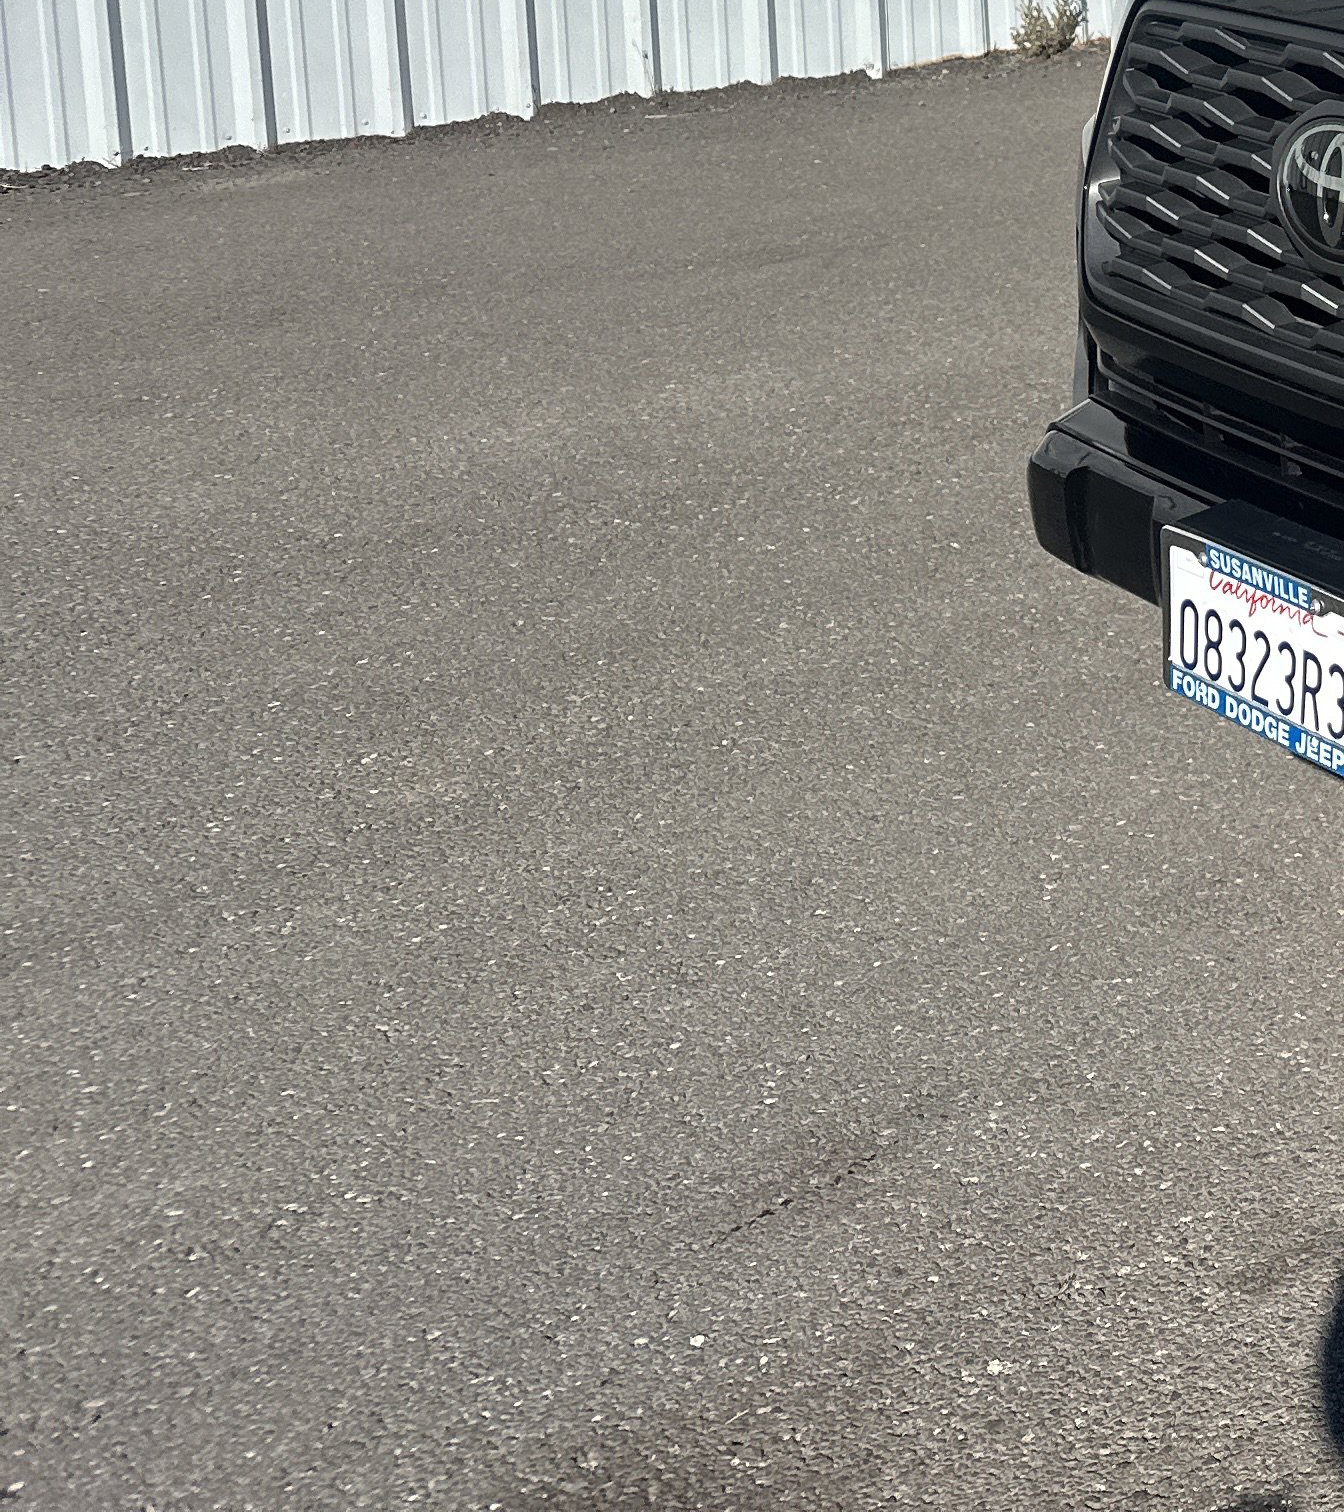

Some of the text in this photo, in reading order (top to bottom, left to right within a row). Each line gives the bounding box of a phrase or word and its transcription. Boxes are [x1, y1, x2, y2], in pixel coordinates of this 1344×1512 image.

[1209, 549, 1310, 609] SUSANVILLE
[1172, 672, 1220, 710] FORD
[1225, 694, 1290, 747] DODGE
